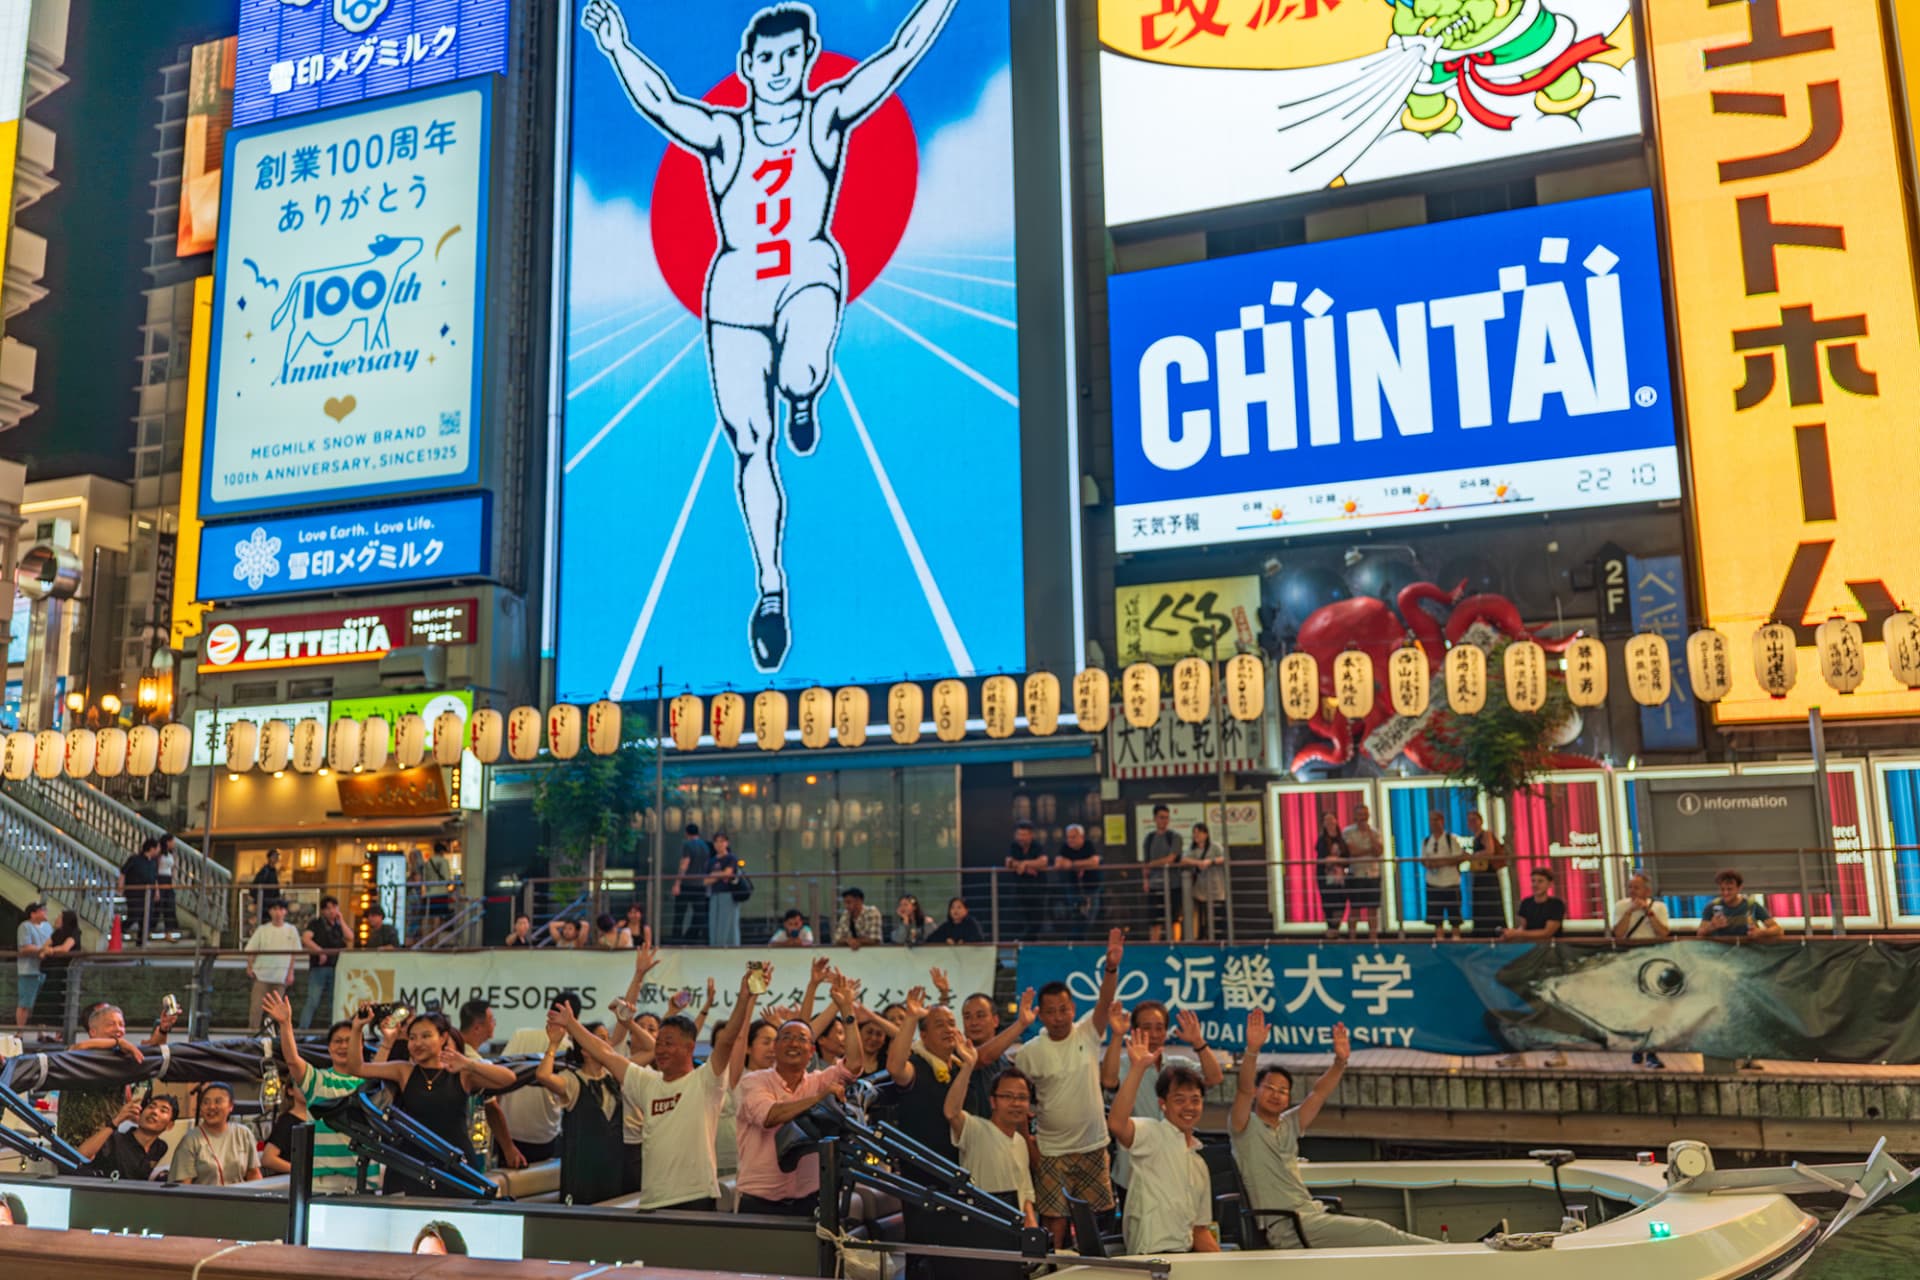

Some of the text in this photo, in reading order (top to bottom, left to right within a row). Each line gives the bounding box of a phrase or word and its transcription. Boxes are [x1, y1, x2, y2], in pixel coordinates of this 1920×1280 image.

[254, 118, 458, 191] 創業100周年
[277, 174, 428, 233] ありがとう
[751, 146, 794, 281] グリコ
[251, 424, 427, 461] MEGMILK SNOW BRAND
[223, 472, 259, 486] 100th
[1577, 462, 1657, 492] 22 10
[298, 515, 435, 544] Love Earth. Love Life.
[1132, 513, 1201, 537] 天気予報
[288, 537, 444, 580] 雪印メグミルク
[1143, 591, 1232, 650] くくる
[243, 624, 391, 662] ZETTERIA
[1703, 794, 1788, 809] information
[399, 985, 461, 1010] MGM
[1163, 952, 1414, 1016] 近畿大学
